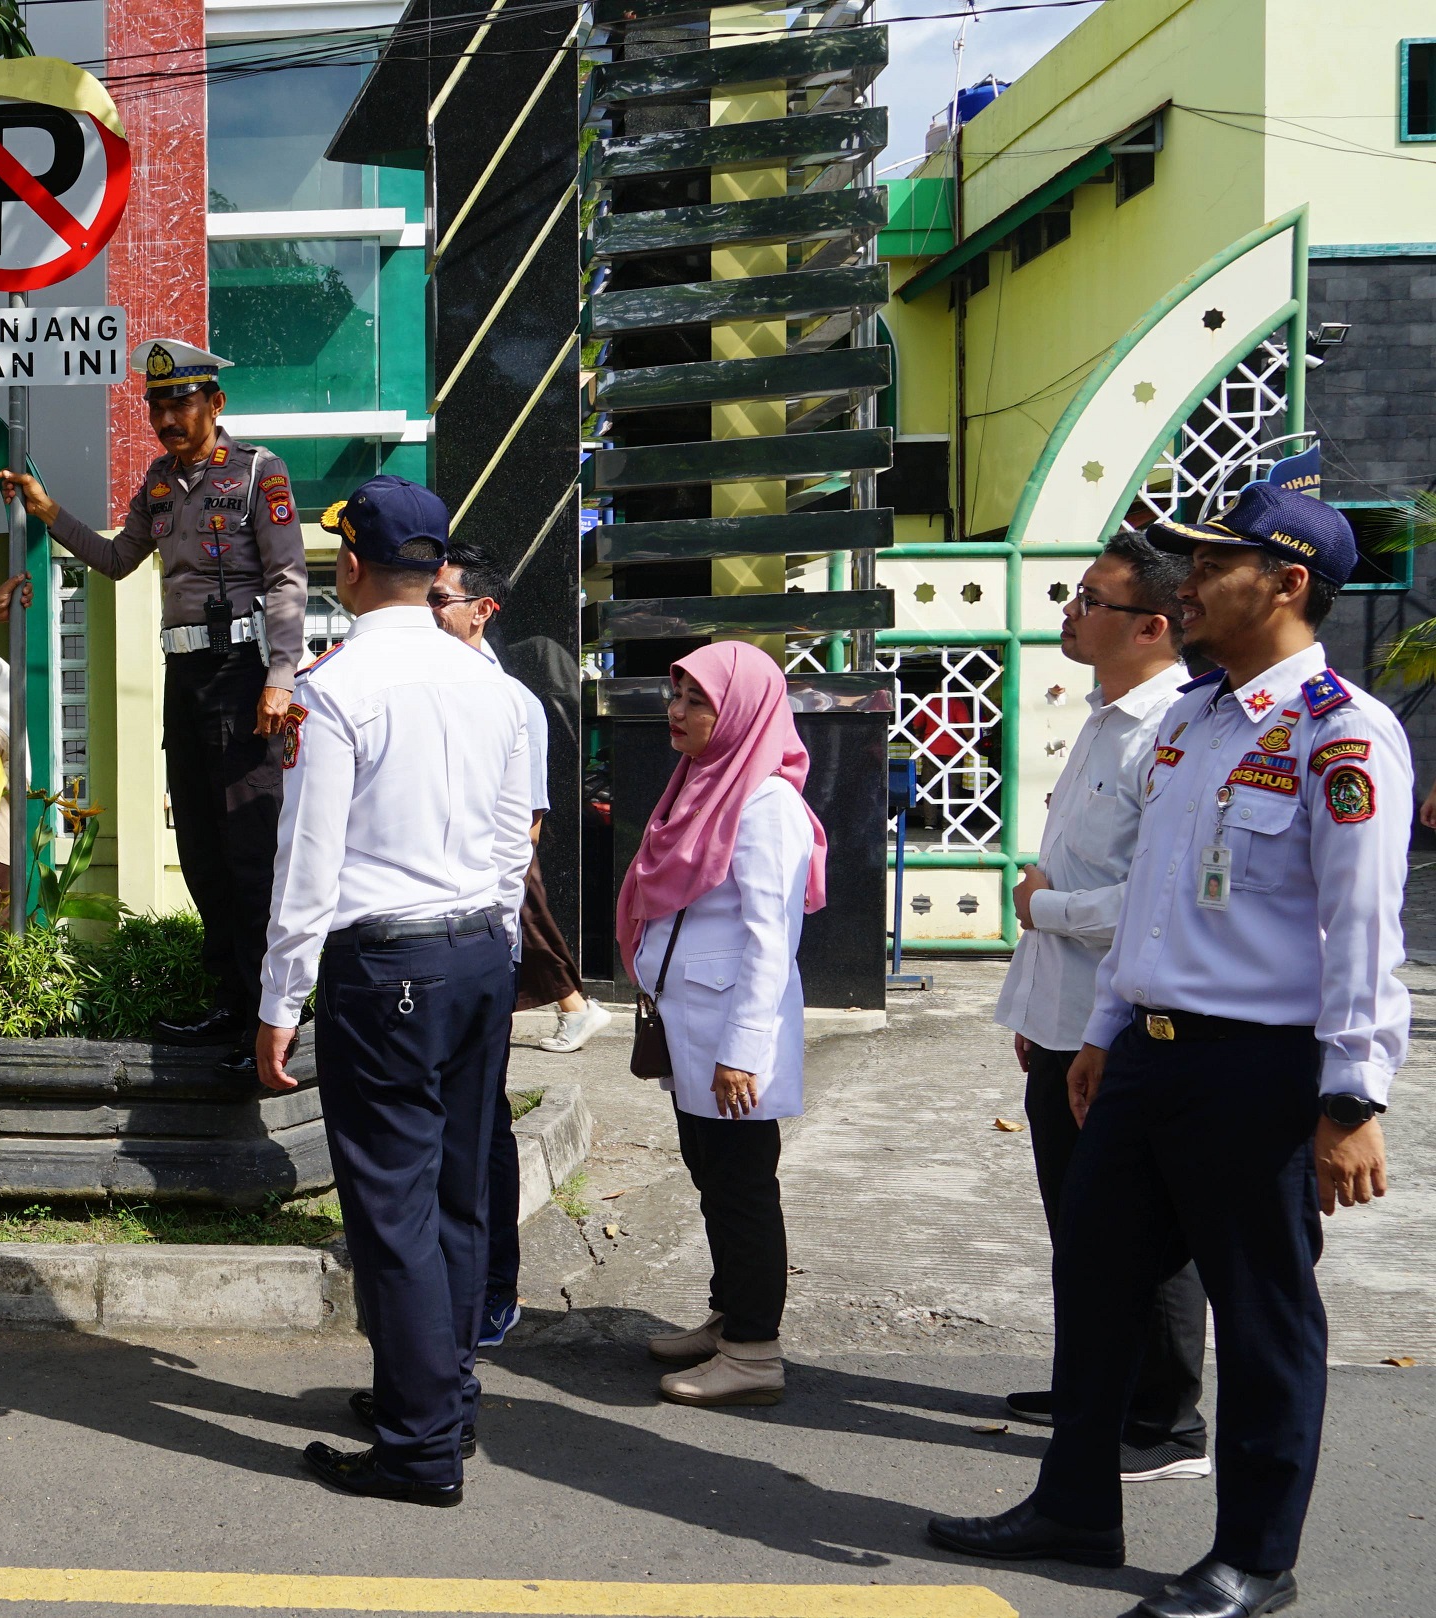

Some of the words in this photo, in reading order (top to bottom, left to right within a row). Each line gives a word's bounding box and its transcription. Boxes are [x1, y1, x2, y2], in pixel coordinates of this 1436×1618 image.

[64, 349, 117, 376] INI
[204, 497, 243, 511] POLRI
[1270, 531, 1317, 557] NDARU
[1229, 769, 1293, 790] DISHUB
